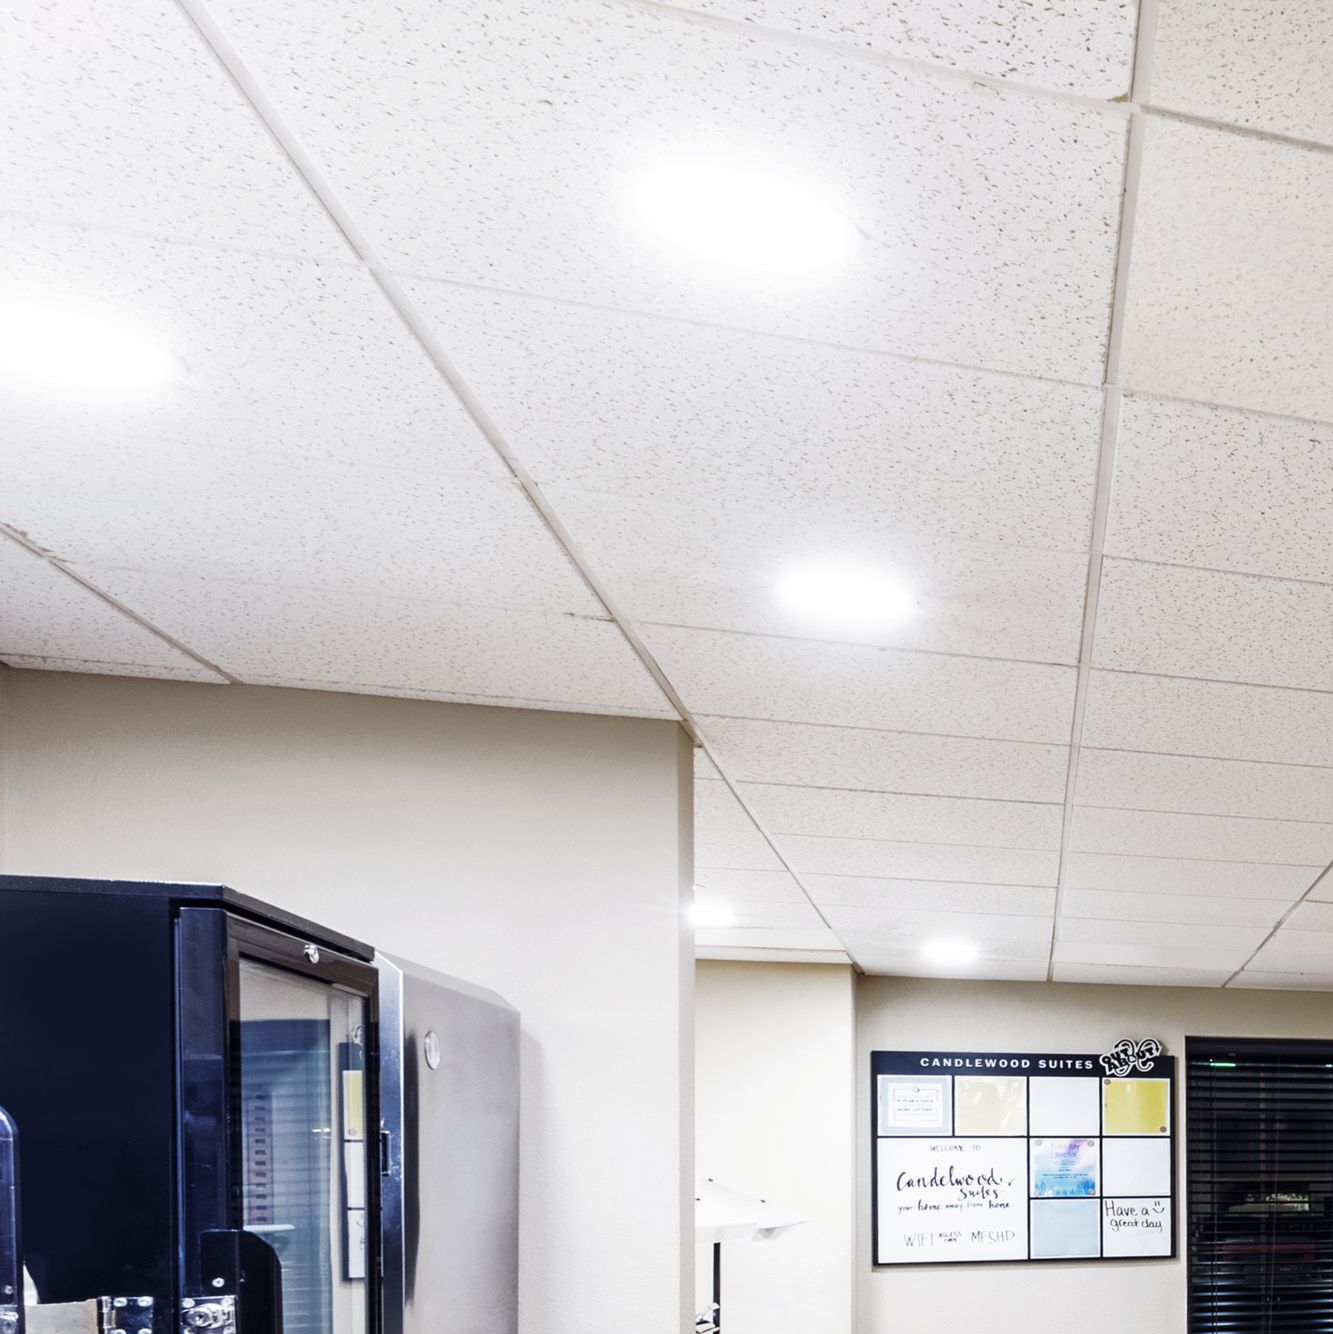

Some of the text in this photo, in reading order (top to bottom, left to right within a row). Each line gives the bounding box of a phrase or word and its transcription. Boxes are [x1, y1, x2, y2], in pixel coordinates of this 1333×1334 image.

[1101, 1046, 1129, 1065] OUT
[920, 1057, 1093, 1069] CANDLEWOOD SUITES
[917, 1198, 942, 1212] home
[988, 1200, 1011, 1209] home
[1105, 1200, 1150, 1217] Have a
[1109, 1218, 1163, 1232] great day
